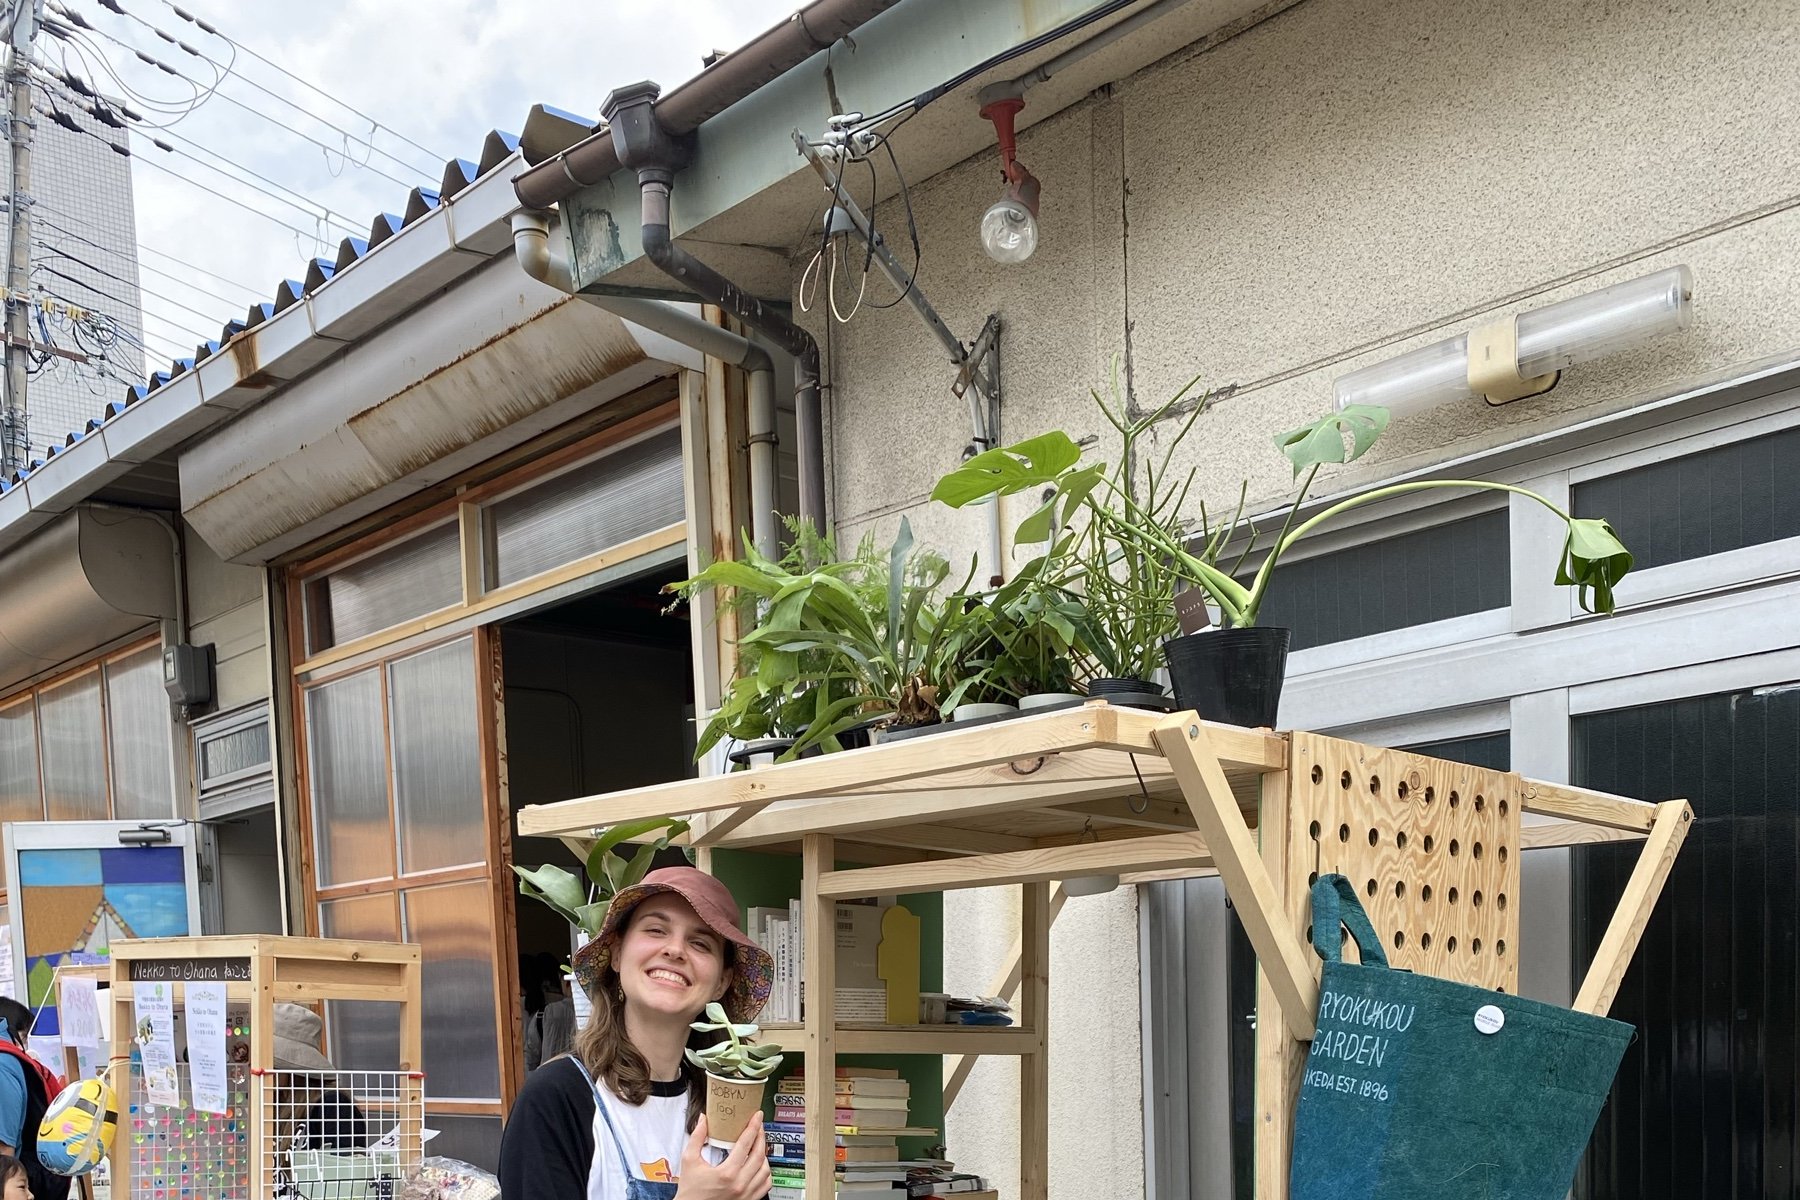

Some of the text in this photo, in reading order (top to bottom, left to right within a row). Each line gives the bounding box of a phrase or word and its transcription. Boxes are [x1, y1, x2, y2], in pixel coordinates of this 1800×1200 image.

[134, 961, 165, 979] Nekko
[169, 963, 180, 978] to
[183, 960, 218, 979] Ohana
[1318, 991, 1415, 1032] RYOKUKOU
[1311, 1028, 1389, 1068] GARDEN
[711, 1082, 746, 1100] ROBYN
[1304, 1068, 1389, 1101] IKEDA EST. 1896
